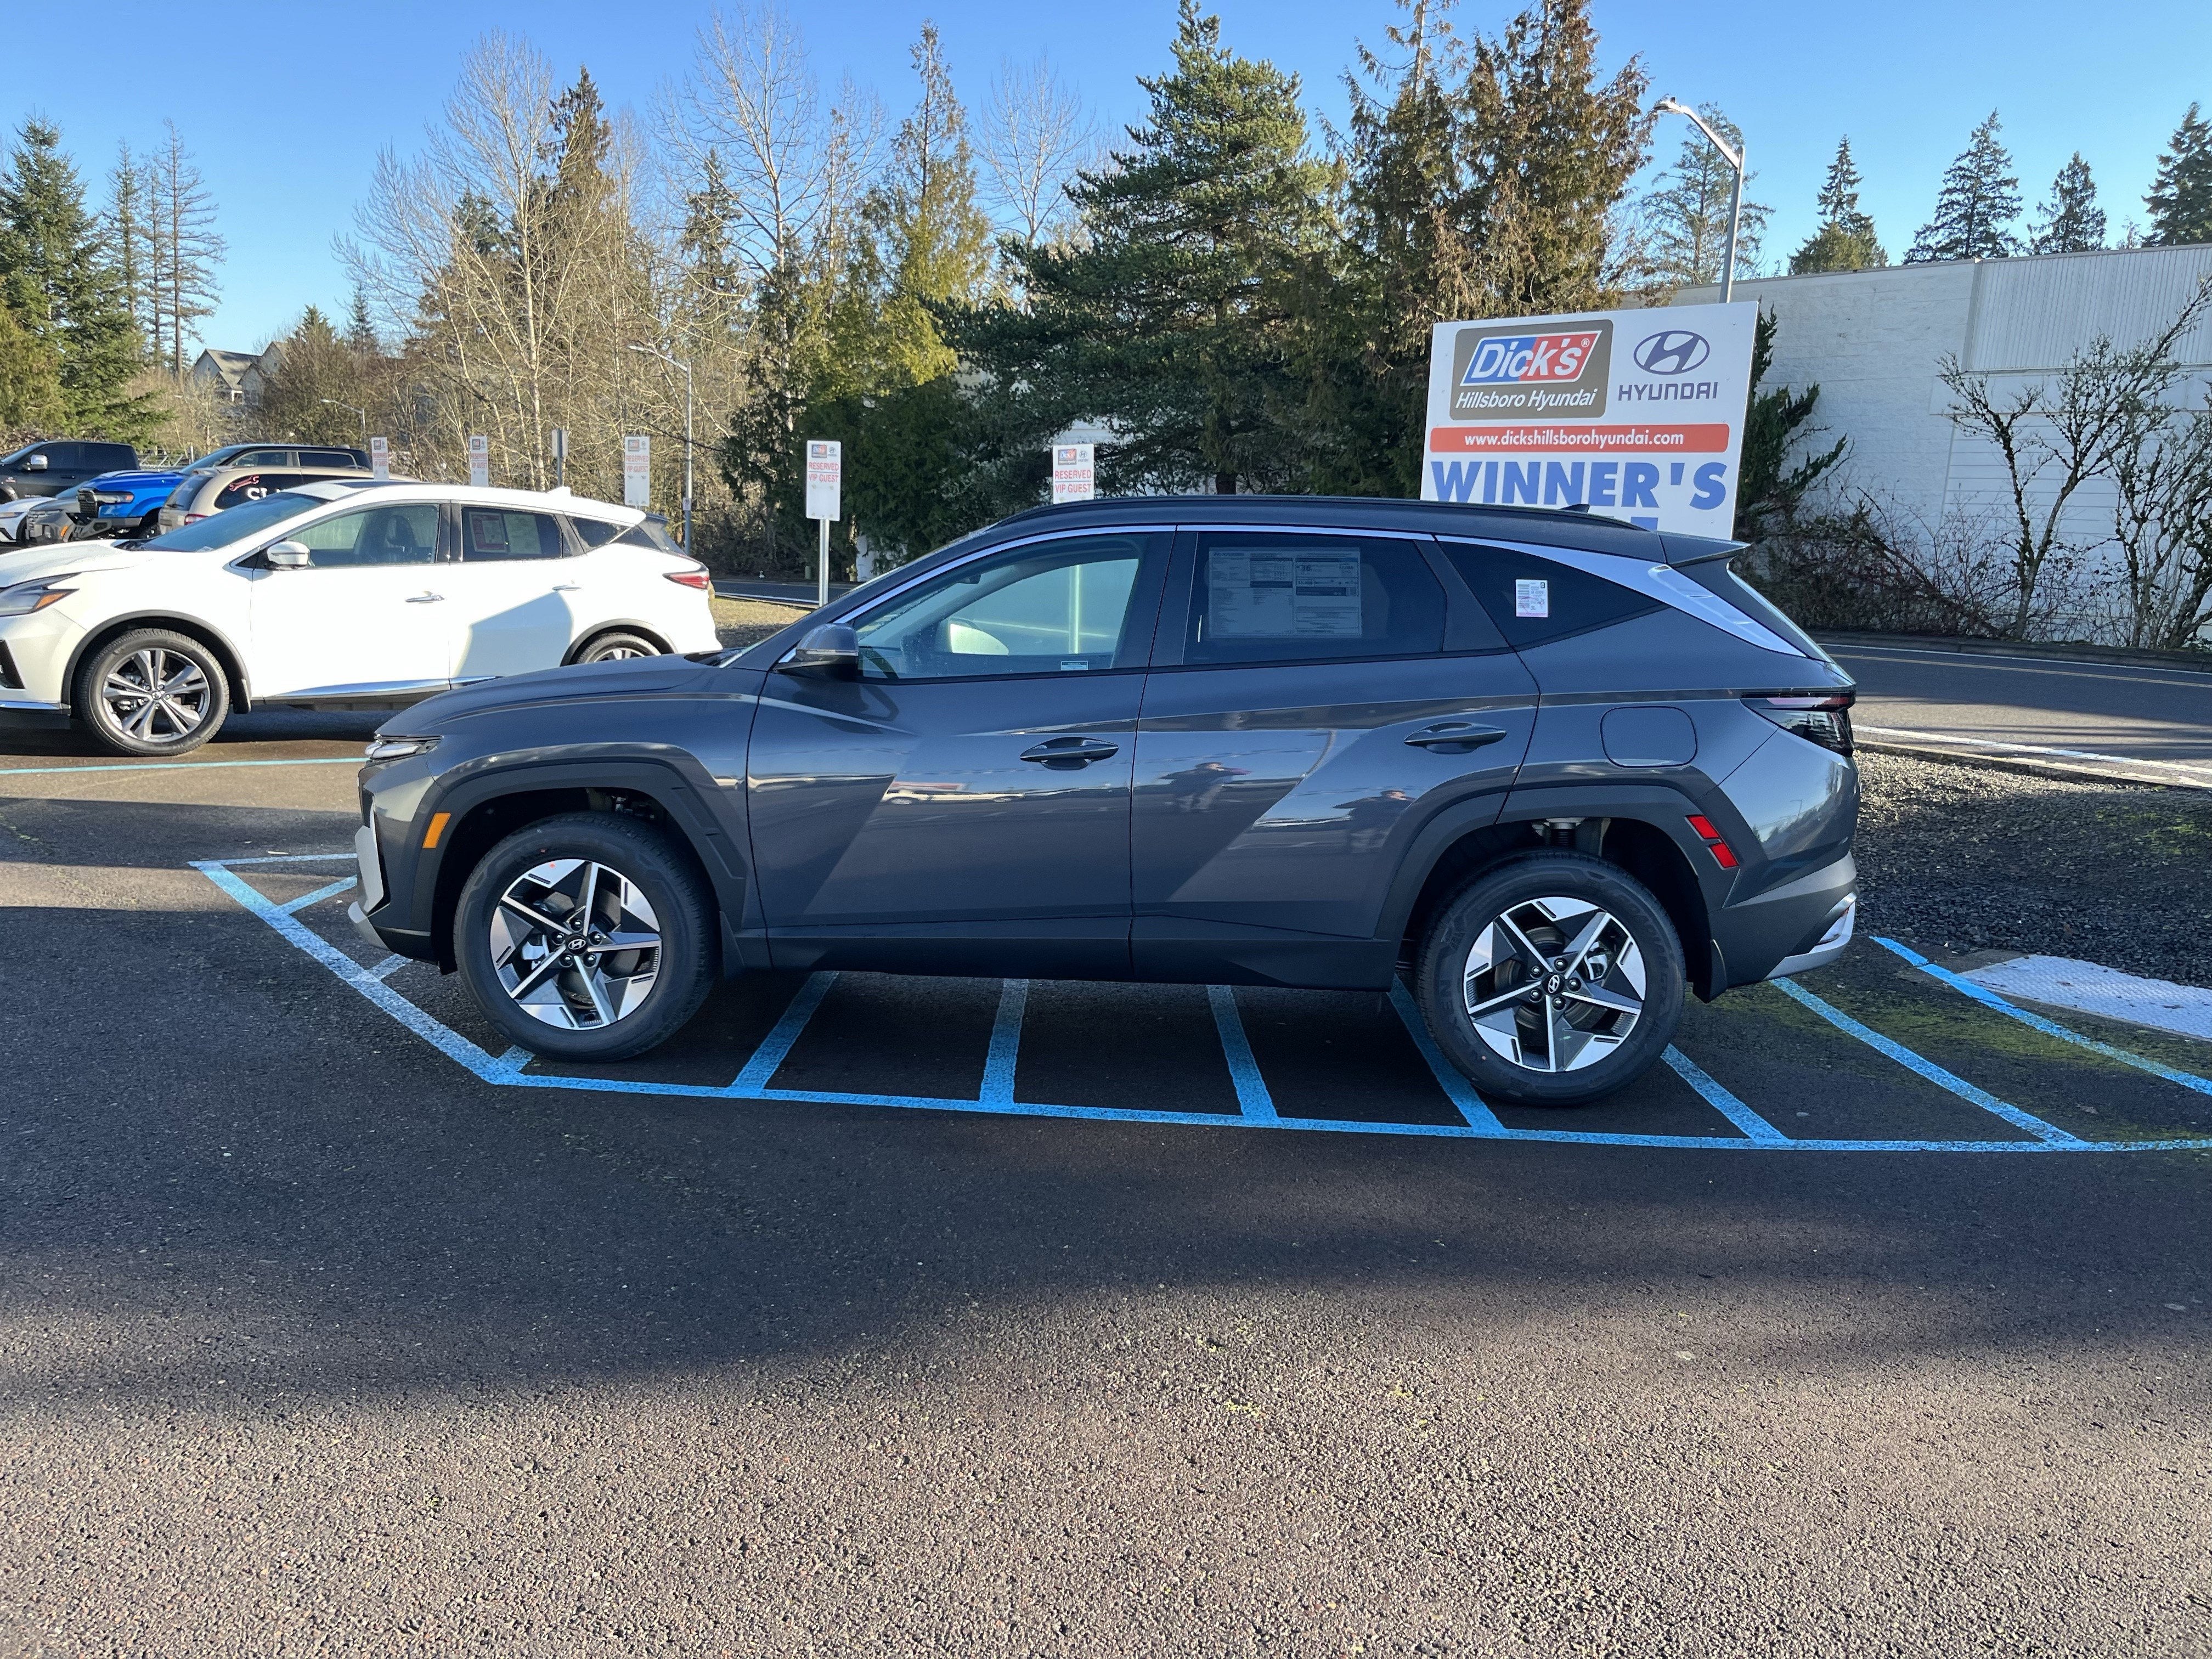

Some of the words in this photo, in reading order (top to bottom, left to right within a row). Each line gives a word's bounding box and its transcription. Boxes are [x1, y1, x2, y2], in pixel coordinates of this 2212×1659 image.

[1471, 338, 1582, 379] Dick's
[1455, 391, 1526, 409] Hillsboro
[1527, 388, 1598, 411] Hyundai
[1618, 382, 1718, 401] HYUNDAI
[1464, 429, 1684, 449] www.dickshillsborohyundai.com
[809, 462, 839, 471] RESERVED
[1055, 469, 1091, 479] RESERVED
[819, 474, 839, 483] GUEST
[1055, 483, 1066, 493] VIP
[1068, 483, 1091, 493] GUEST
[1431, 461, 1728, 510] WINNER'S
